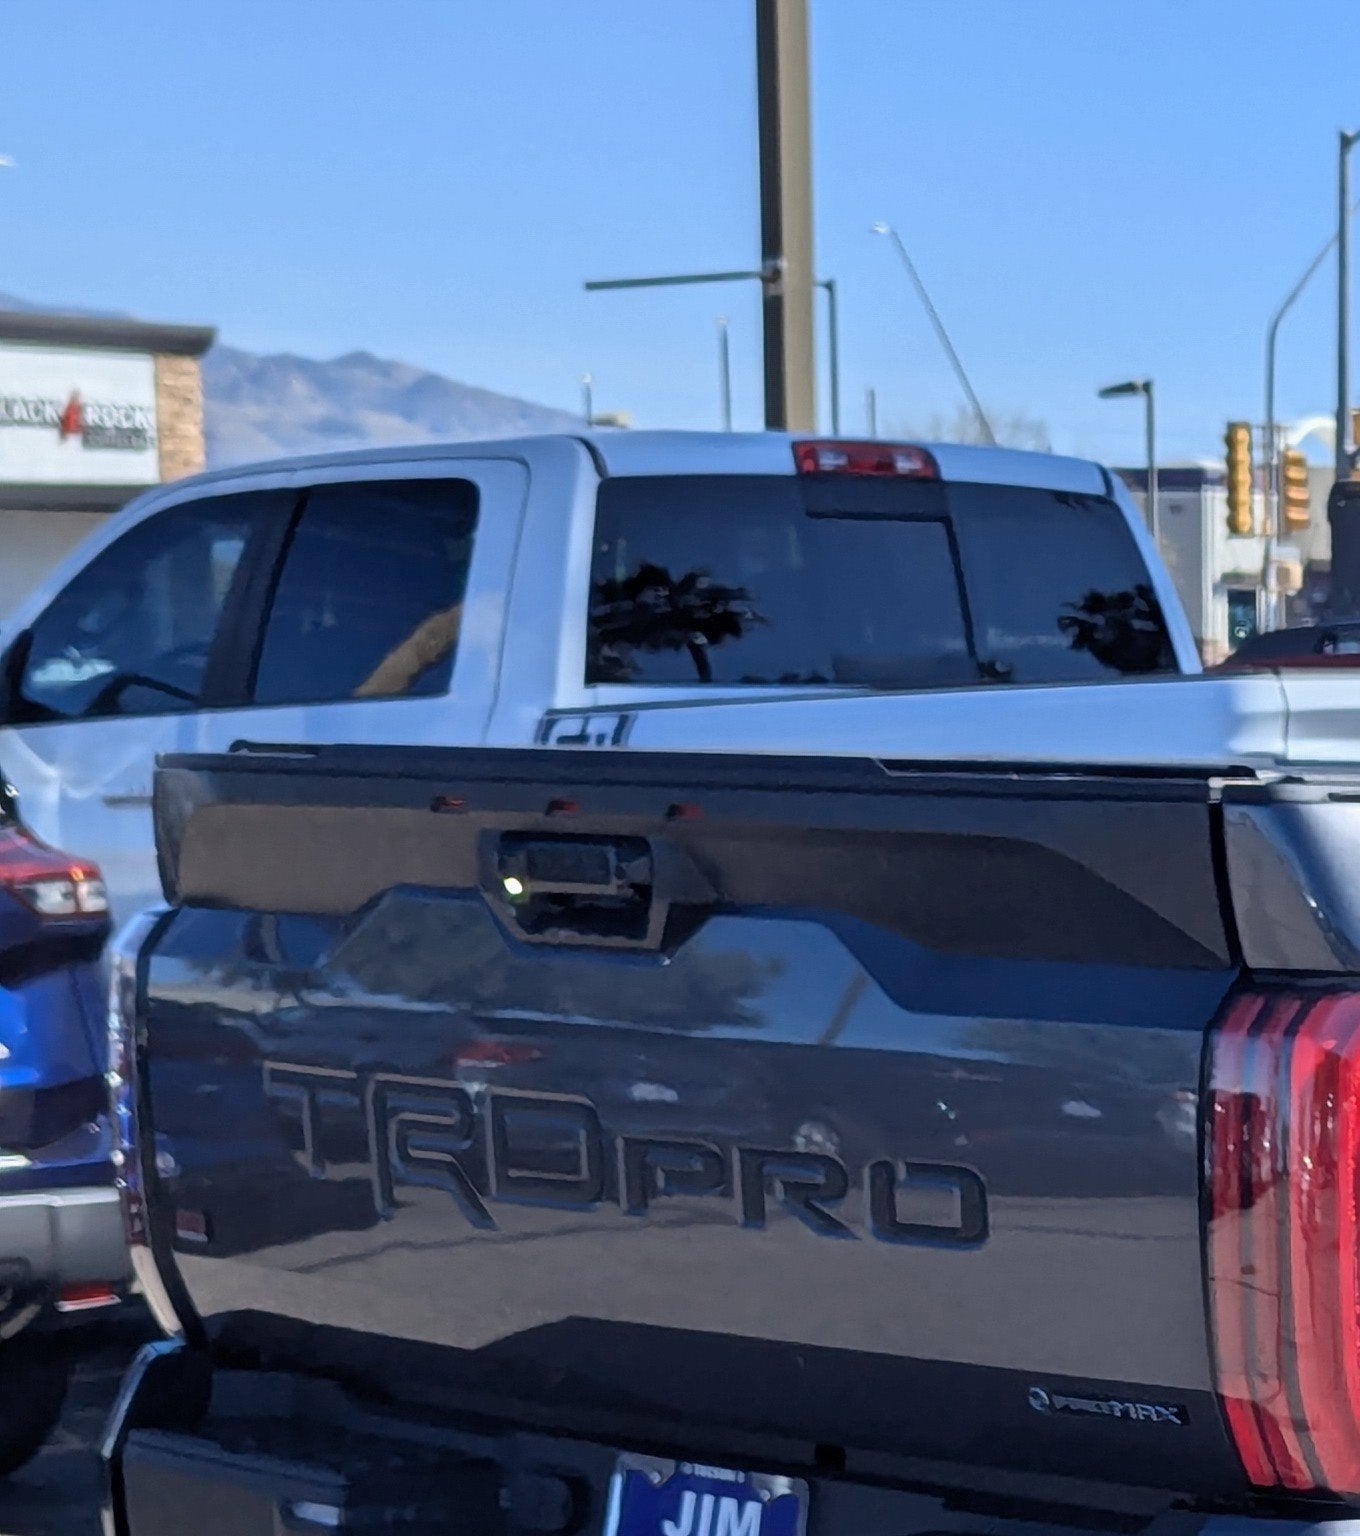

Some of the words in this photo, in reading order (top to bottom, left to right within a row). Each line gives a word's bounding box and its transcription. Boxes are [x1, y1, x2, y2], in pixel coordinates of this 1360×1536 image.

[0, 396, 62, 426] LACK
[262, 1059, 604, 1231] TRD
[615, 1134, 990, 1250] PRO
